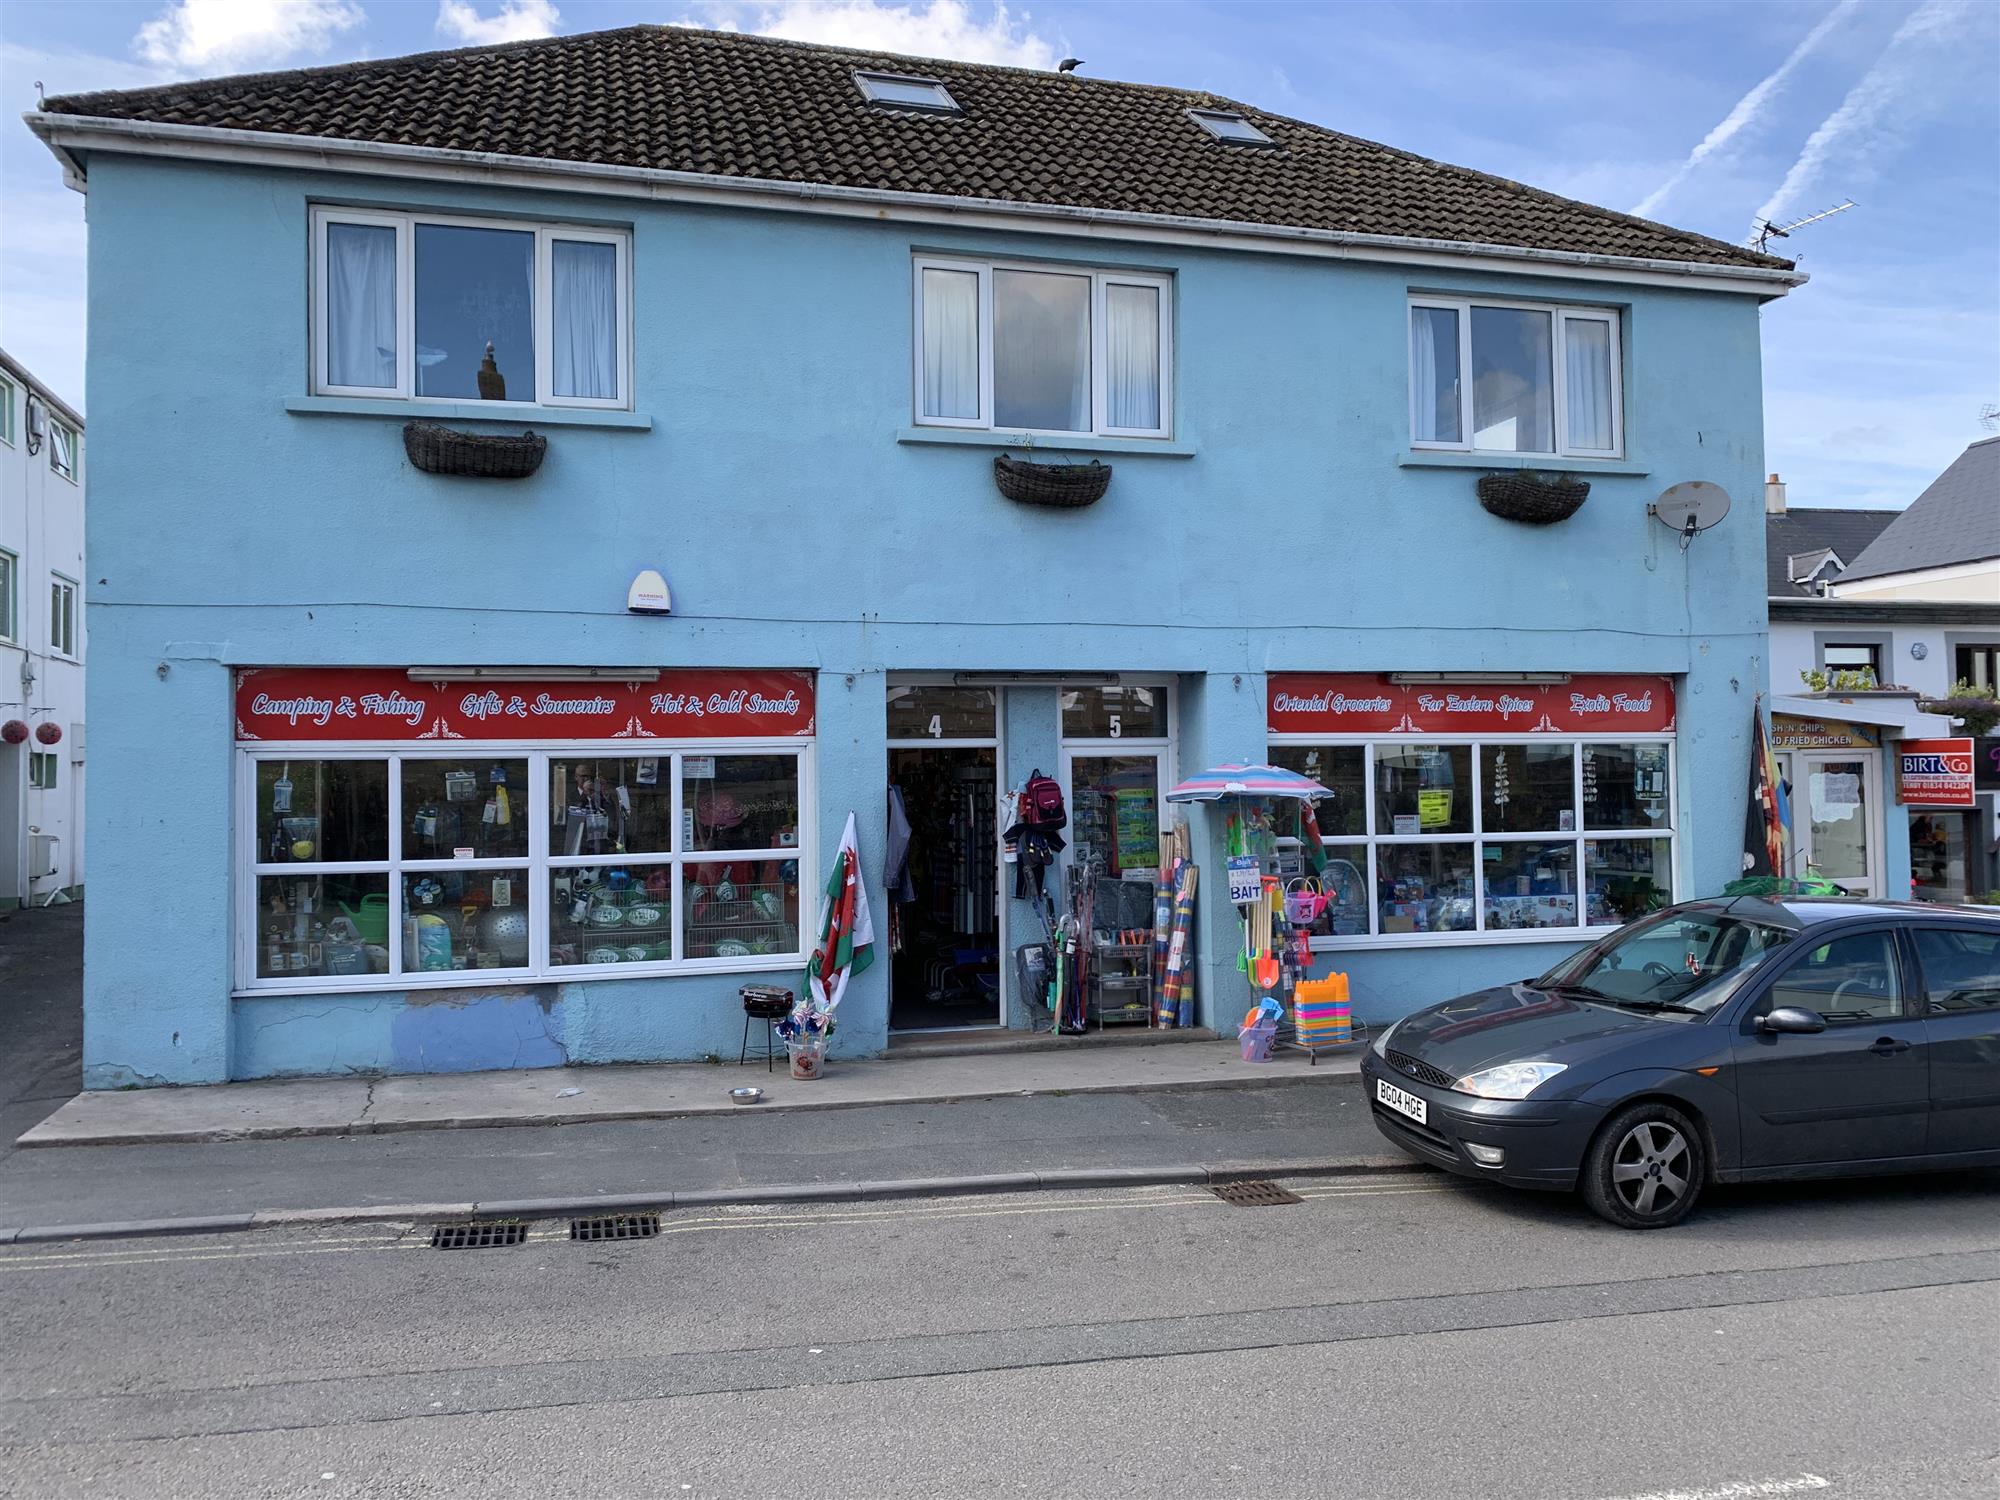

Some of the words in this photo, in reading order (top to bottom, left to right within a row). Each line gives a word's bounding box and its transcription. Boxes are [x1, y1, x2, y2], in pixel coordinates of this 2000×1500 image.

[252, 692, 333, 726] Camping
[335, 696, 357, 718] &
[360, 690, 425, 726] Fishing
[460, 689, 503, 720] Gifts
[505, 696, 527, 717] &
[530, 692, 616, 716] Souvenirs
[650, 692, 685, 715] Hot
[685, 696, 704, 717] &
[707, 689, 747, 714] Cold
[745, 689, 800, 716] Snacks
[1273, 690, 1332, 713] Oriental
[1331, 694, 1392, 715] Groceries
[1418, 694, 1445, 713] Far
[1446, 694, 1493, 713] Eastern
[1495, 694, 1535, 721] Spices
[1569, 692, 1610, 716] Exotic
[1612, 690, 1652, 713] Foods
[928, 714, 942, 738] 4
[1109, 714, 1121, 738] 5
[1771, 723, 1783, 732] SH
[1800, 723, 1826, 732] CHIPS
[1772, 736, 1782, 745] ND
[1784, 736, 1810, 745] FRIED
[1812, 736, 1853, 745] CHICKEN
[1230, 886, 1261, 900] BAIT
[1380, 1082, 1402, 1108] BG04
[1404, 1093, 1423, 1118] HGE
